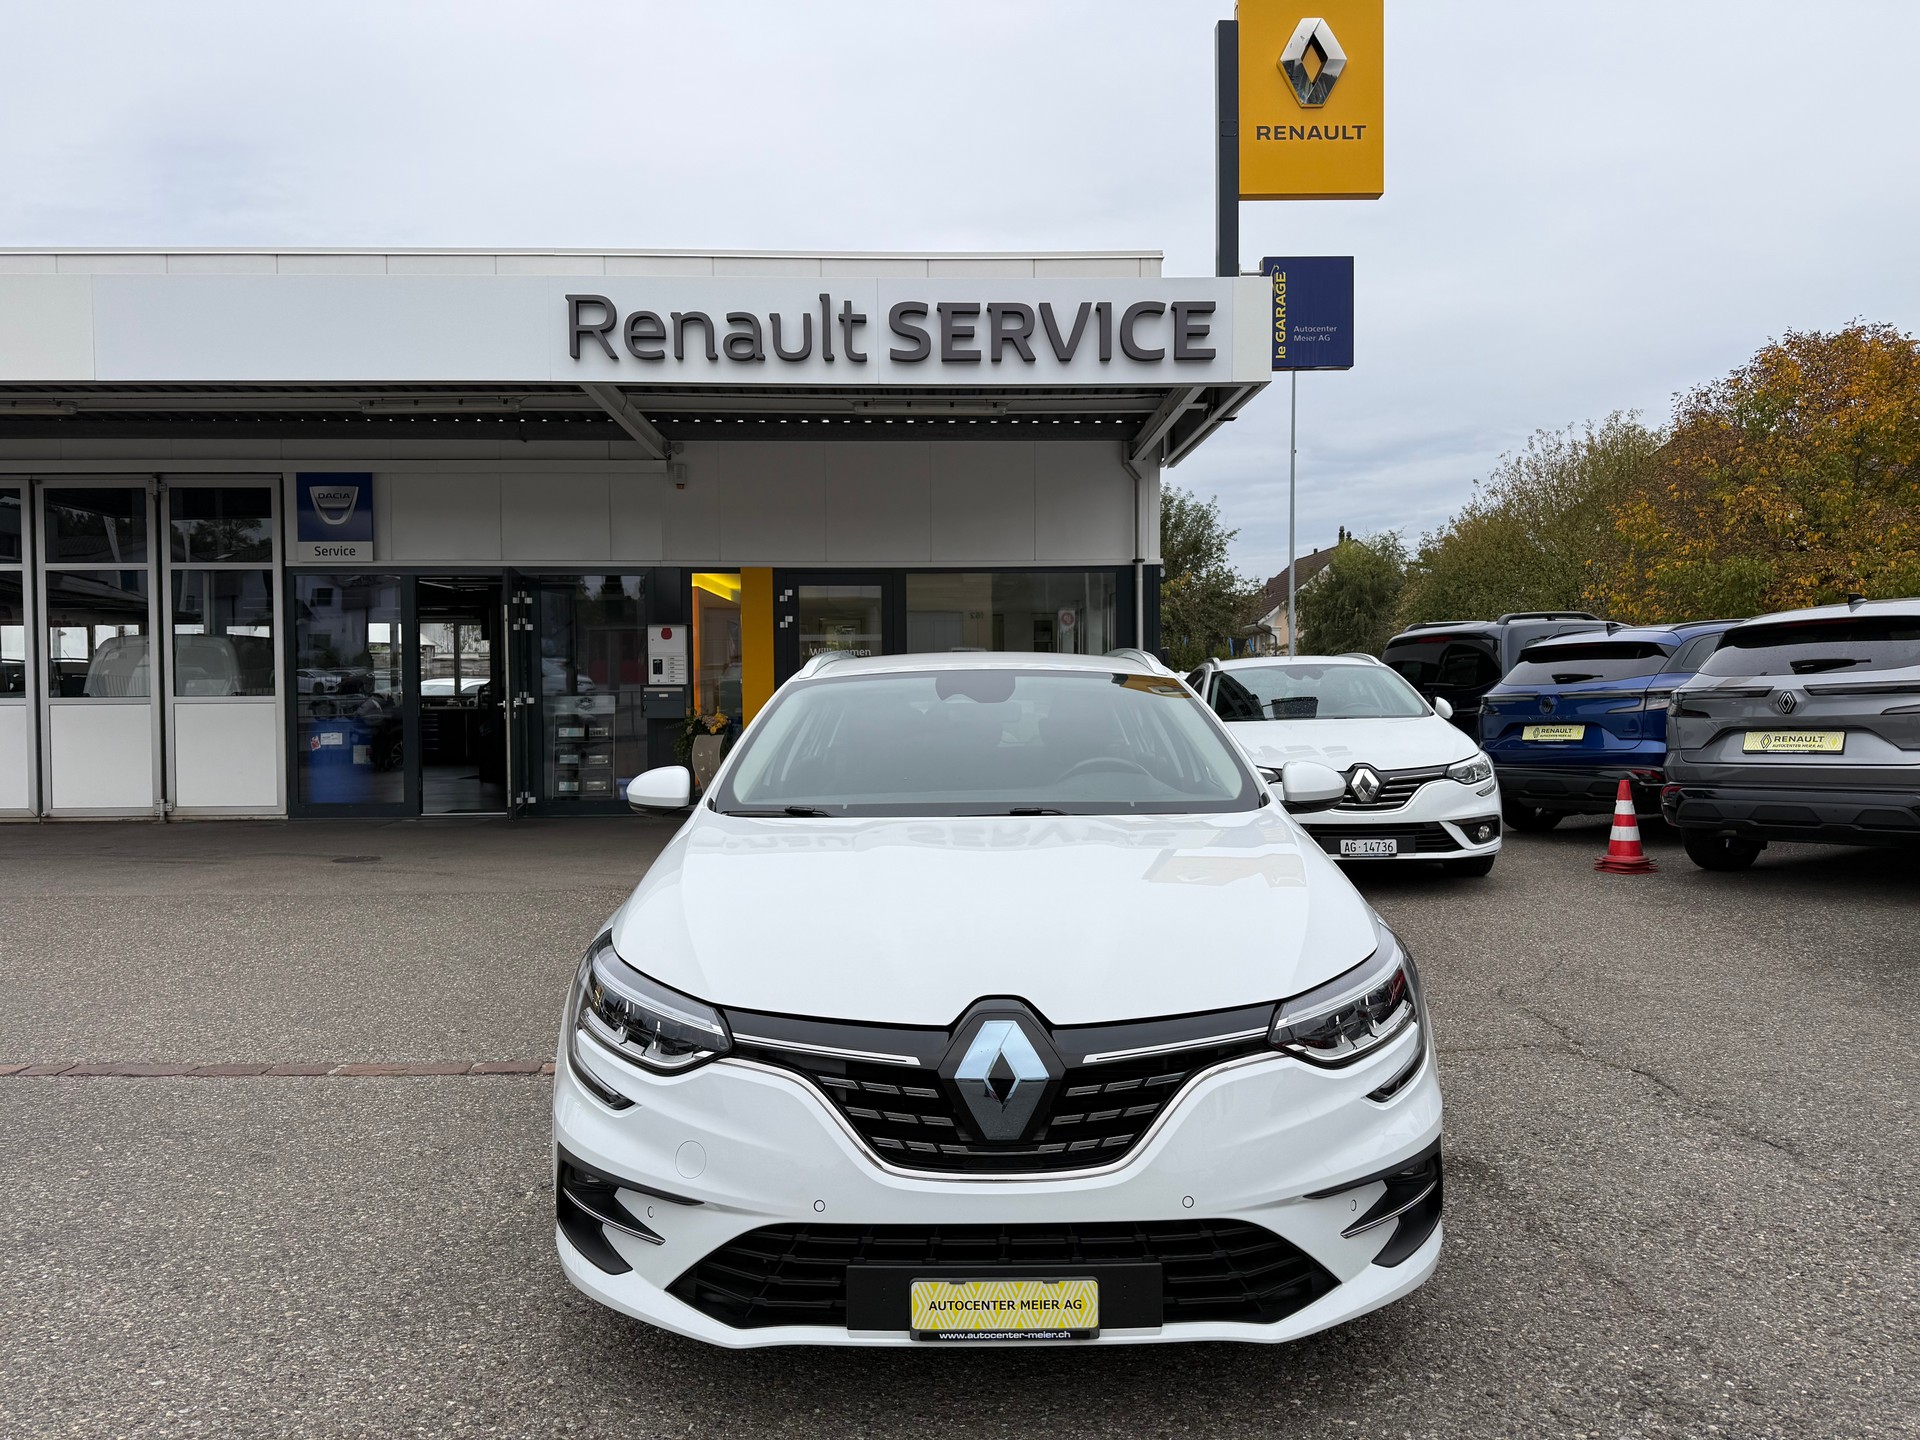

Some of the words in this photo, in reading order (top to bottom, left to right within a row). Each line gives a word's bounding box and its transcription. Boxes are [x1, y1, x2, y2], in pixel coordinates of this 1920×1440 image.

[1256, 125, 1366, 140] RENAULT
[1275, 272, 1286, 342] GARAGE
[565, 293, 867, 362] Renault
[889, 301, 1216, 362] SERVICE
[1275, 346, 1286, 358] le
[314, 545, 356, 556] Service
[1773, 735, 1825, 743] RENAULT
[929, 1300, 1017, 1310] AUTOCENTER
[1020, 1300, 1060, 1310] MEIER
[1064, 1299, 1082, 1310] AG
[939, 1330, 1071, 1339] www.autocenter-meier.ch
